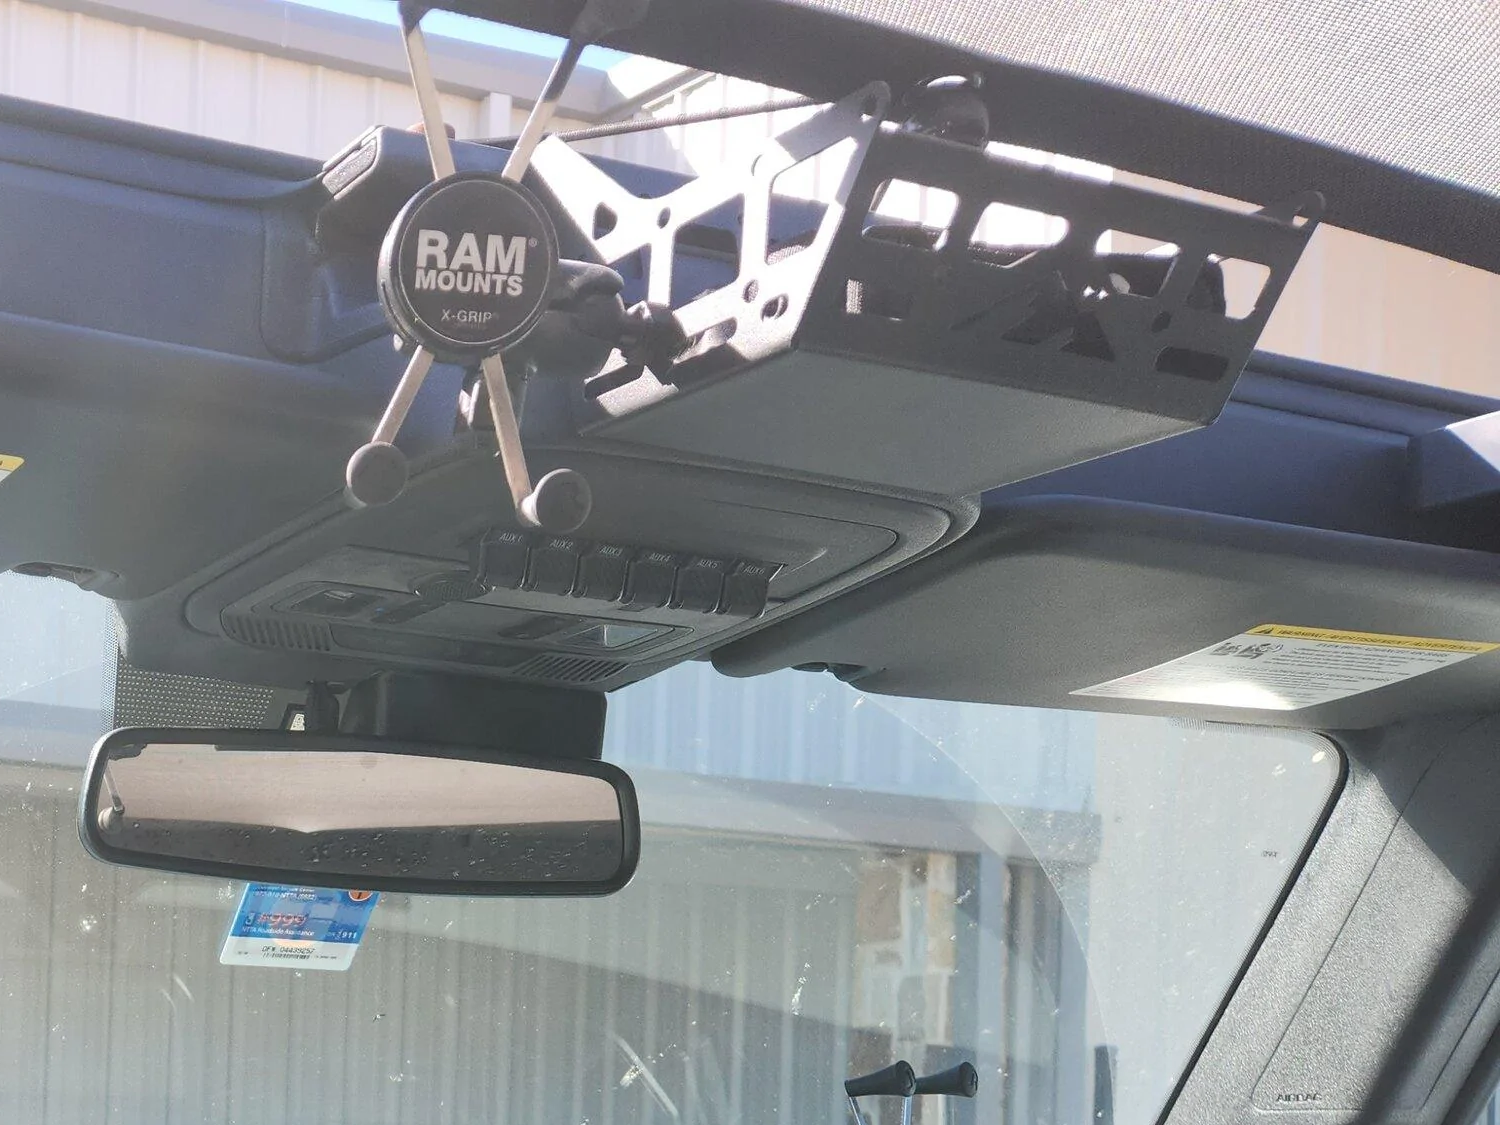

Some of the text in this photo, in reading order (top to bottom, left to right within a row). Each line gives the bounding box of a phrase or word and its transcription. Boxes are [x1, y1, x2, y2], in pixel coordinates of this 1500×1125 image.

[417, 229, 527, 274] RAM
[415, 268, 524, 296] MOUNTS
[441, 309, 493, 323] X-GRIP
